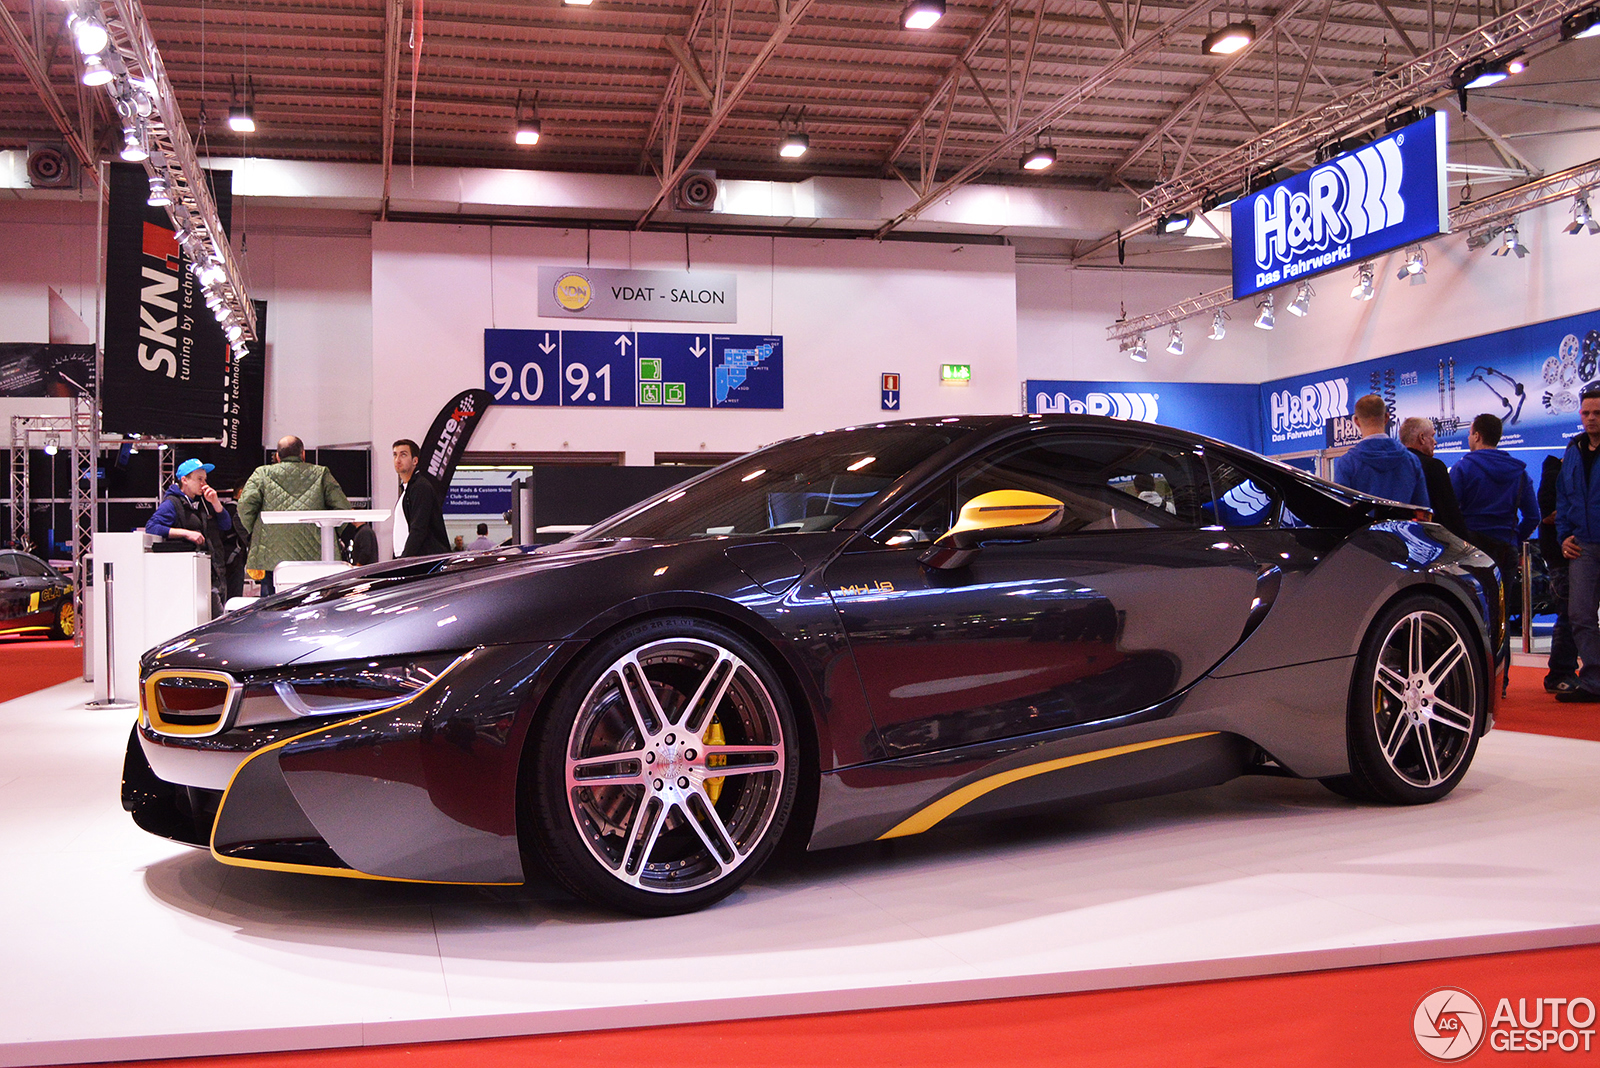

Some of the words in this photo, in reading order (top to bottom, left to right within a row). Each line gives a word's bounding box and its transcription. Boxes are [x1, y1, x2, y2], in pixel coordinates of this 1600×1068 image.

[1254, 165, 1351, 270] H&R
[181, 251, 194, 308] technol
[1256, 269, 1280, 288] Das
[1283, 244, 1351, 279] Fahrwerk!
[611, 286, 655, 302] VDAT
[670, 288, 725, 304] SALON
[138, 266, 180, 379] SKN
[181, 314, 194, 331] by
[180, 336, 194, 381] tuning
[488, 361, 544, 401] 9.0
[565, 362, 611, 401] 9.1
[230, 402, 240, 415] by
[1270, 384, 1322, 434] H&R
[229, 418, 240, 450] tuning
[438, 424, 463, 478] SPORT
[1272, 434, 1286, 442] Das
[1287, 427, 1323, 440] Fahrwerk!
[840, 583, 870, 597] MH
